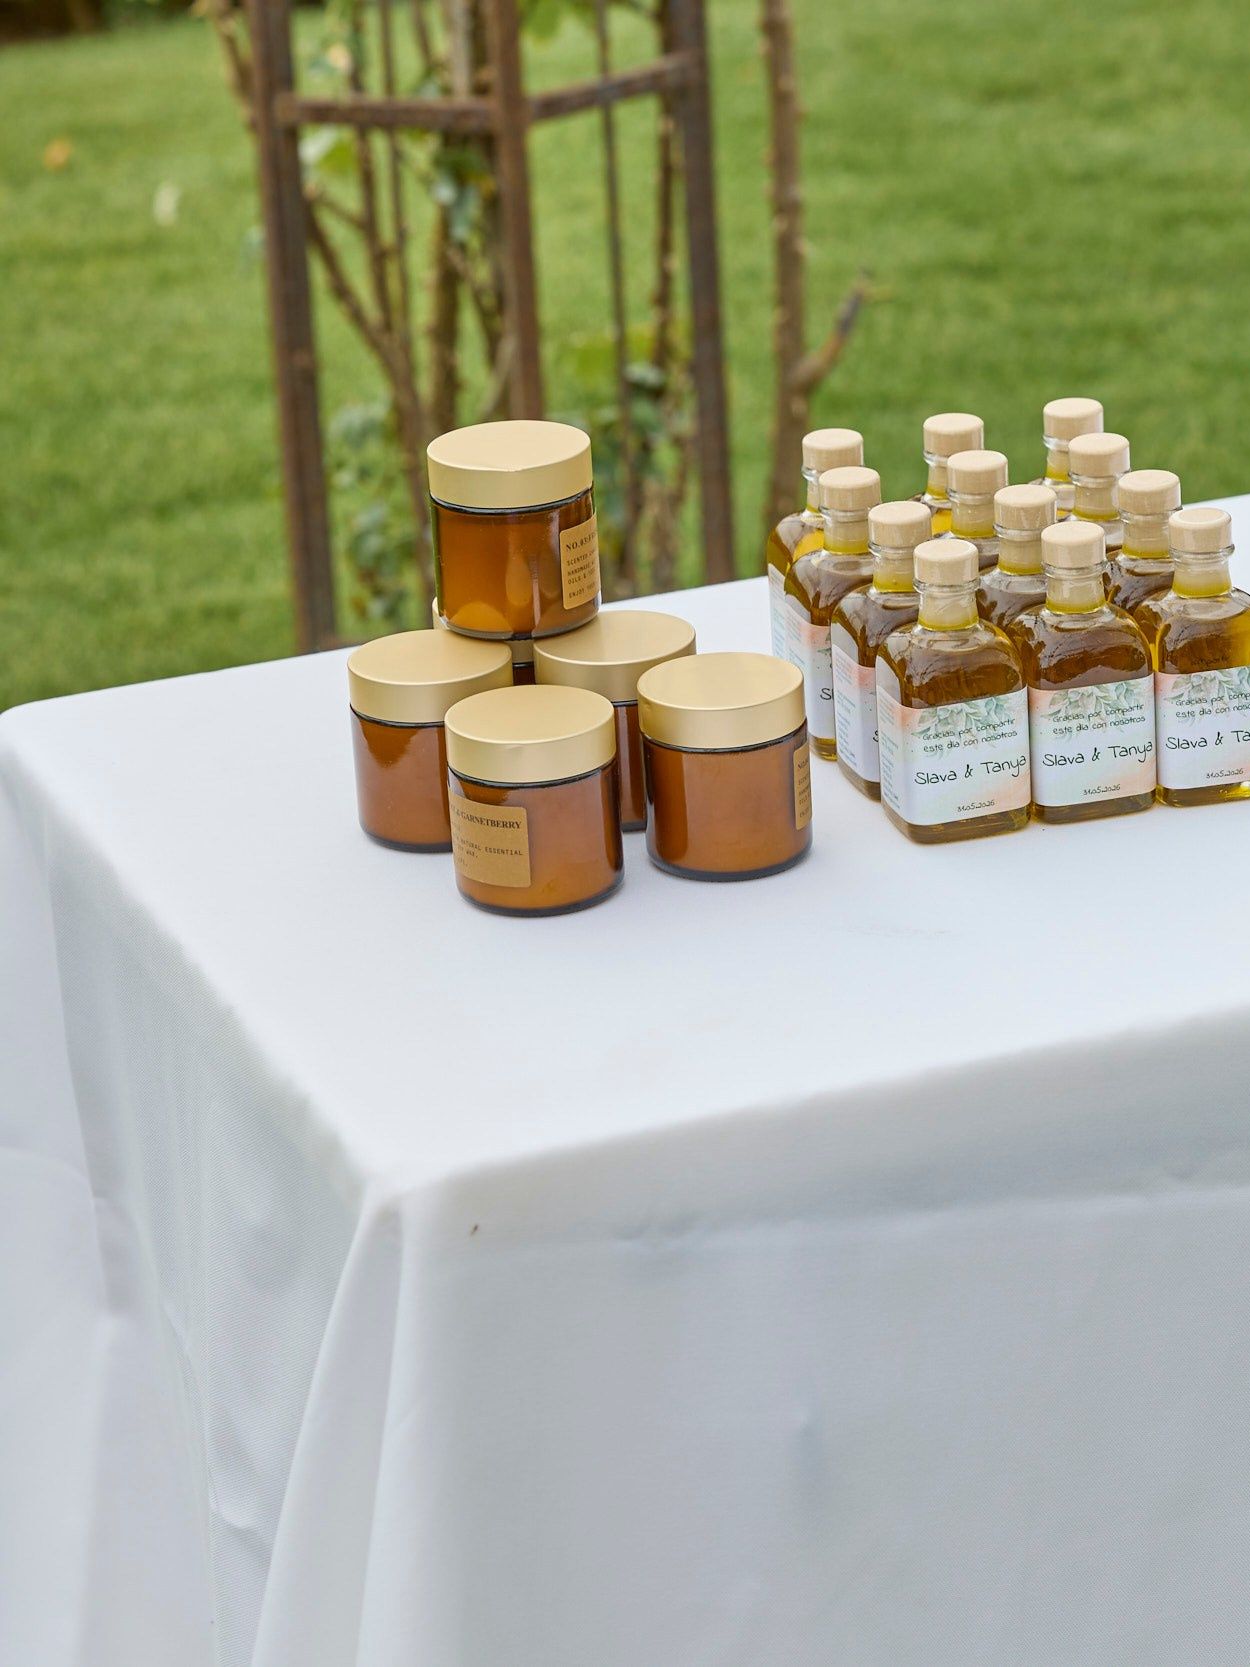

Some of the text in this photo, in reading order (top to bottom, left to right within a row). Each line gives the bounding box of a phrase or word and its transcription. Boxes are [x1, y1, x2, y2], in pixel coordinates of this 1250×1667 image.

[1176, 697, 1207, 706] Gracias
[1211, 695, 1225, 705] por
[1053, 704, 1144, 723] Gracias por compartir
[1176, 710, 1195, 718] este
[1215, 706, 1230, 714] con
[923, 718, 1015, 741] Gracias por compartir
[1053, 726, 1072, 735] este
[1092, 721, 1107, 729] con
[1110, 716, 1146, 727] nosotros
[924, 744, 943, 752] este
[964, 738, 978, 746] con
[982, 730, 1018, 743] nosotros
[1166, 736, 1207, 749] Slava
[1215, 732, 1224, 745] &
[1042, 741, 1153, 766] Slava & Tanya
[914, 756, 1027, 784] Slava & Tanya
[461, 812, 522, 829] GARNETBERRY
[485, 847, 523, 856] ESSENTIAL
